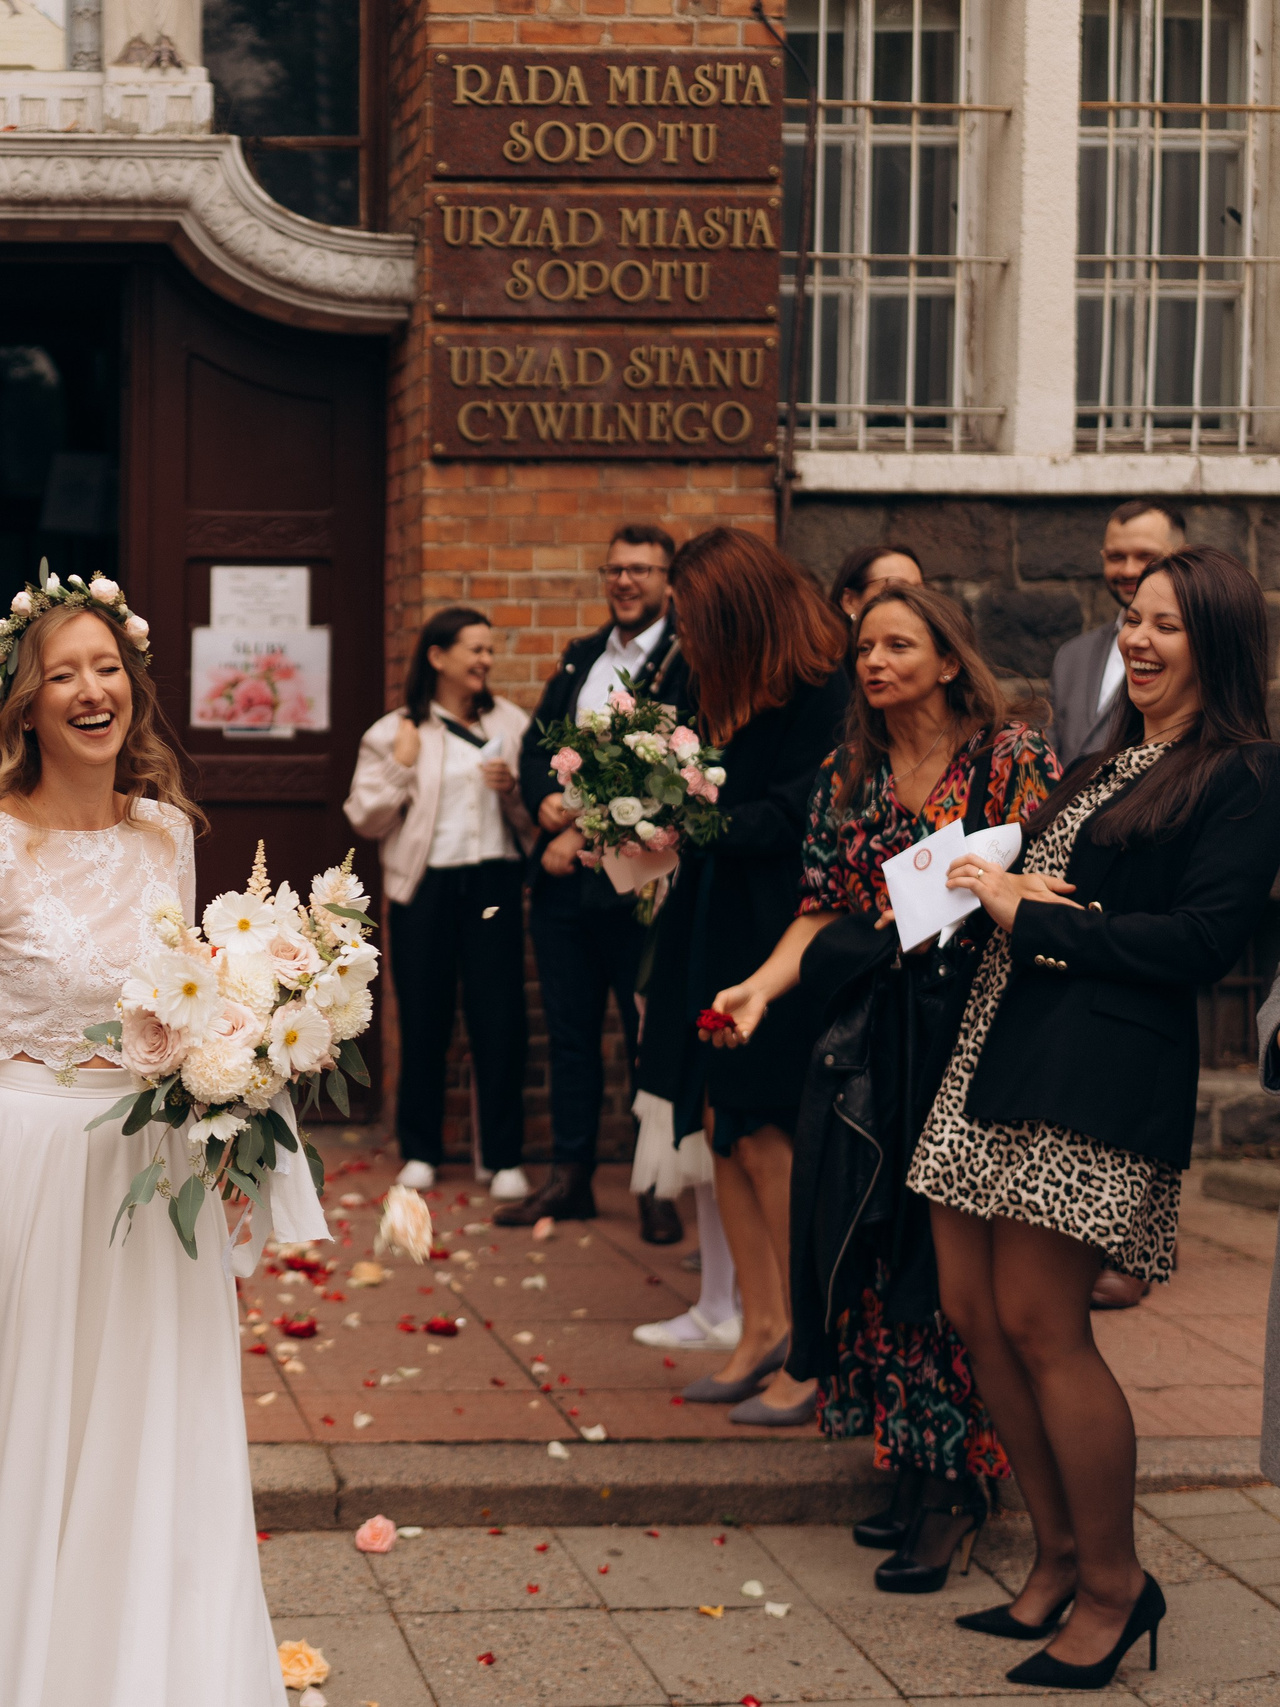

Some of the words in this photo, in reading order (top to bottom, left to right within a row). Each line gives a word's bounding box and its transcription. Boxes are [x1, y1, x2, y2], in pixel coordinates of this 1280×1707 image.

[452, 64, 593, 106] RADA
[606, 62, 772, 106] MIASTA
[503, 119, 720, 165] SOPOTU
[440, 203, 604, 252] URZĄD
[618, 204, 777, 249] MIASTA
[505, 257, 712, 302] SOPOTU
[448, 346, 614, 391] URZĄD
[623, 344, 765, 390] STANU
[457, 400, 754, 444] CYWILNEGO
